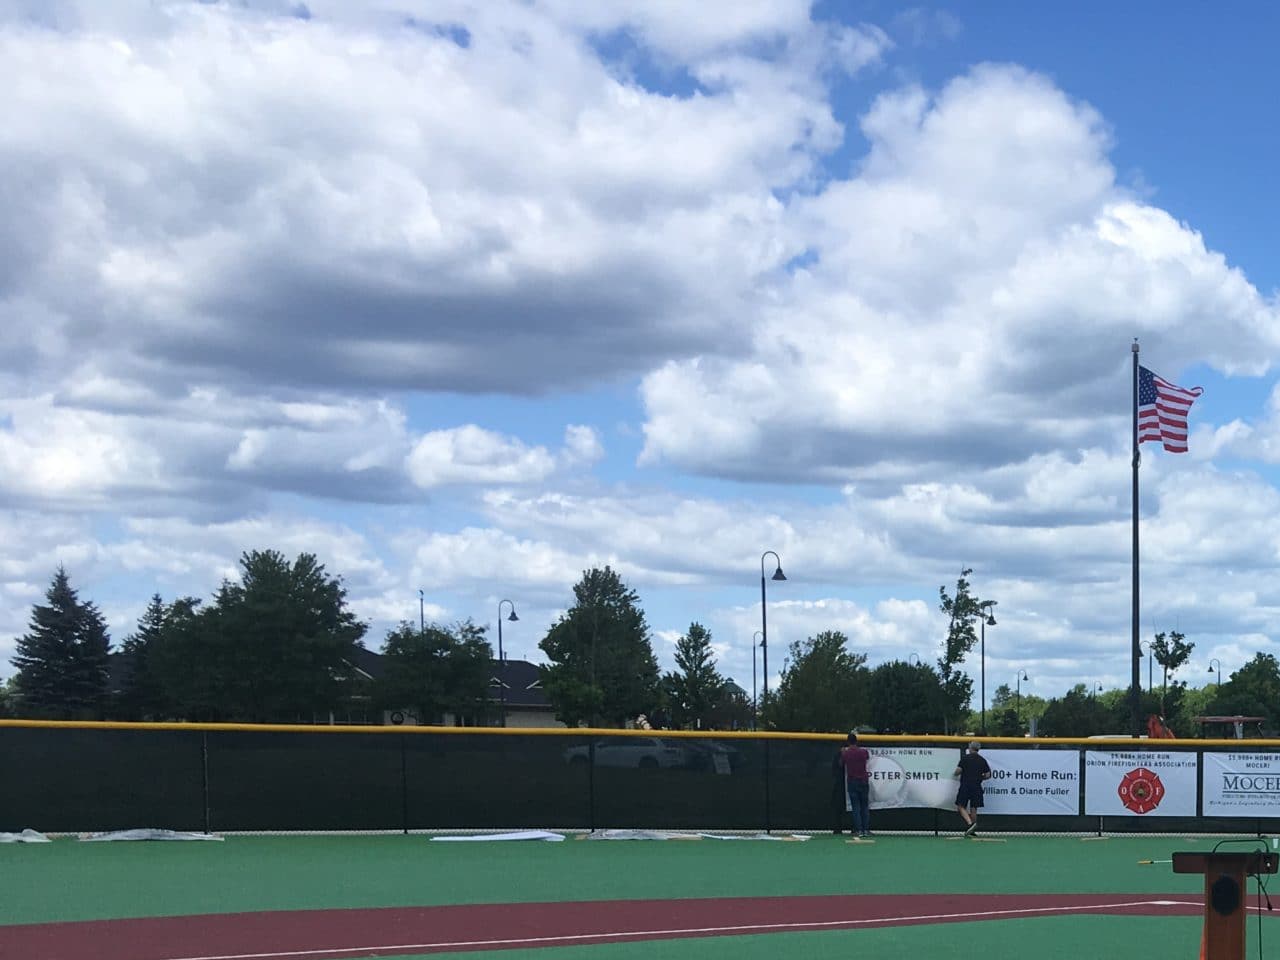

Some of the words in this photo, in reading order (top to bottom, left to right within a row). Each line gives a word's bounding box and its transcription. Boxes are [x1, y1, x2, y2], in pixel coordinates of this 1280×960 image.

[866, 771, 901, 780] PETER
[905, 771, 940, 780] SMIDT
[1015, 769, 1047, 780] Home
[1051, 770, 1077, 780] Run:
[1010, 787, 1017, 795] &
[1019, 787, 1043, 795] Diane
[1045, 787, 1070, 795] Fuller
